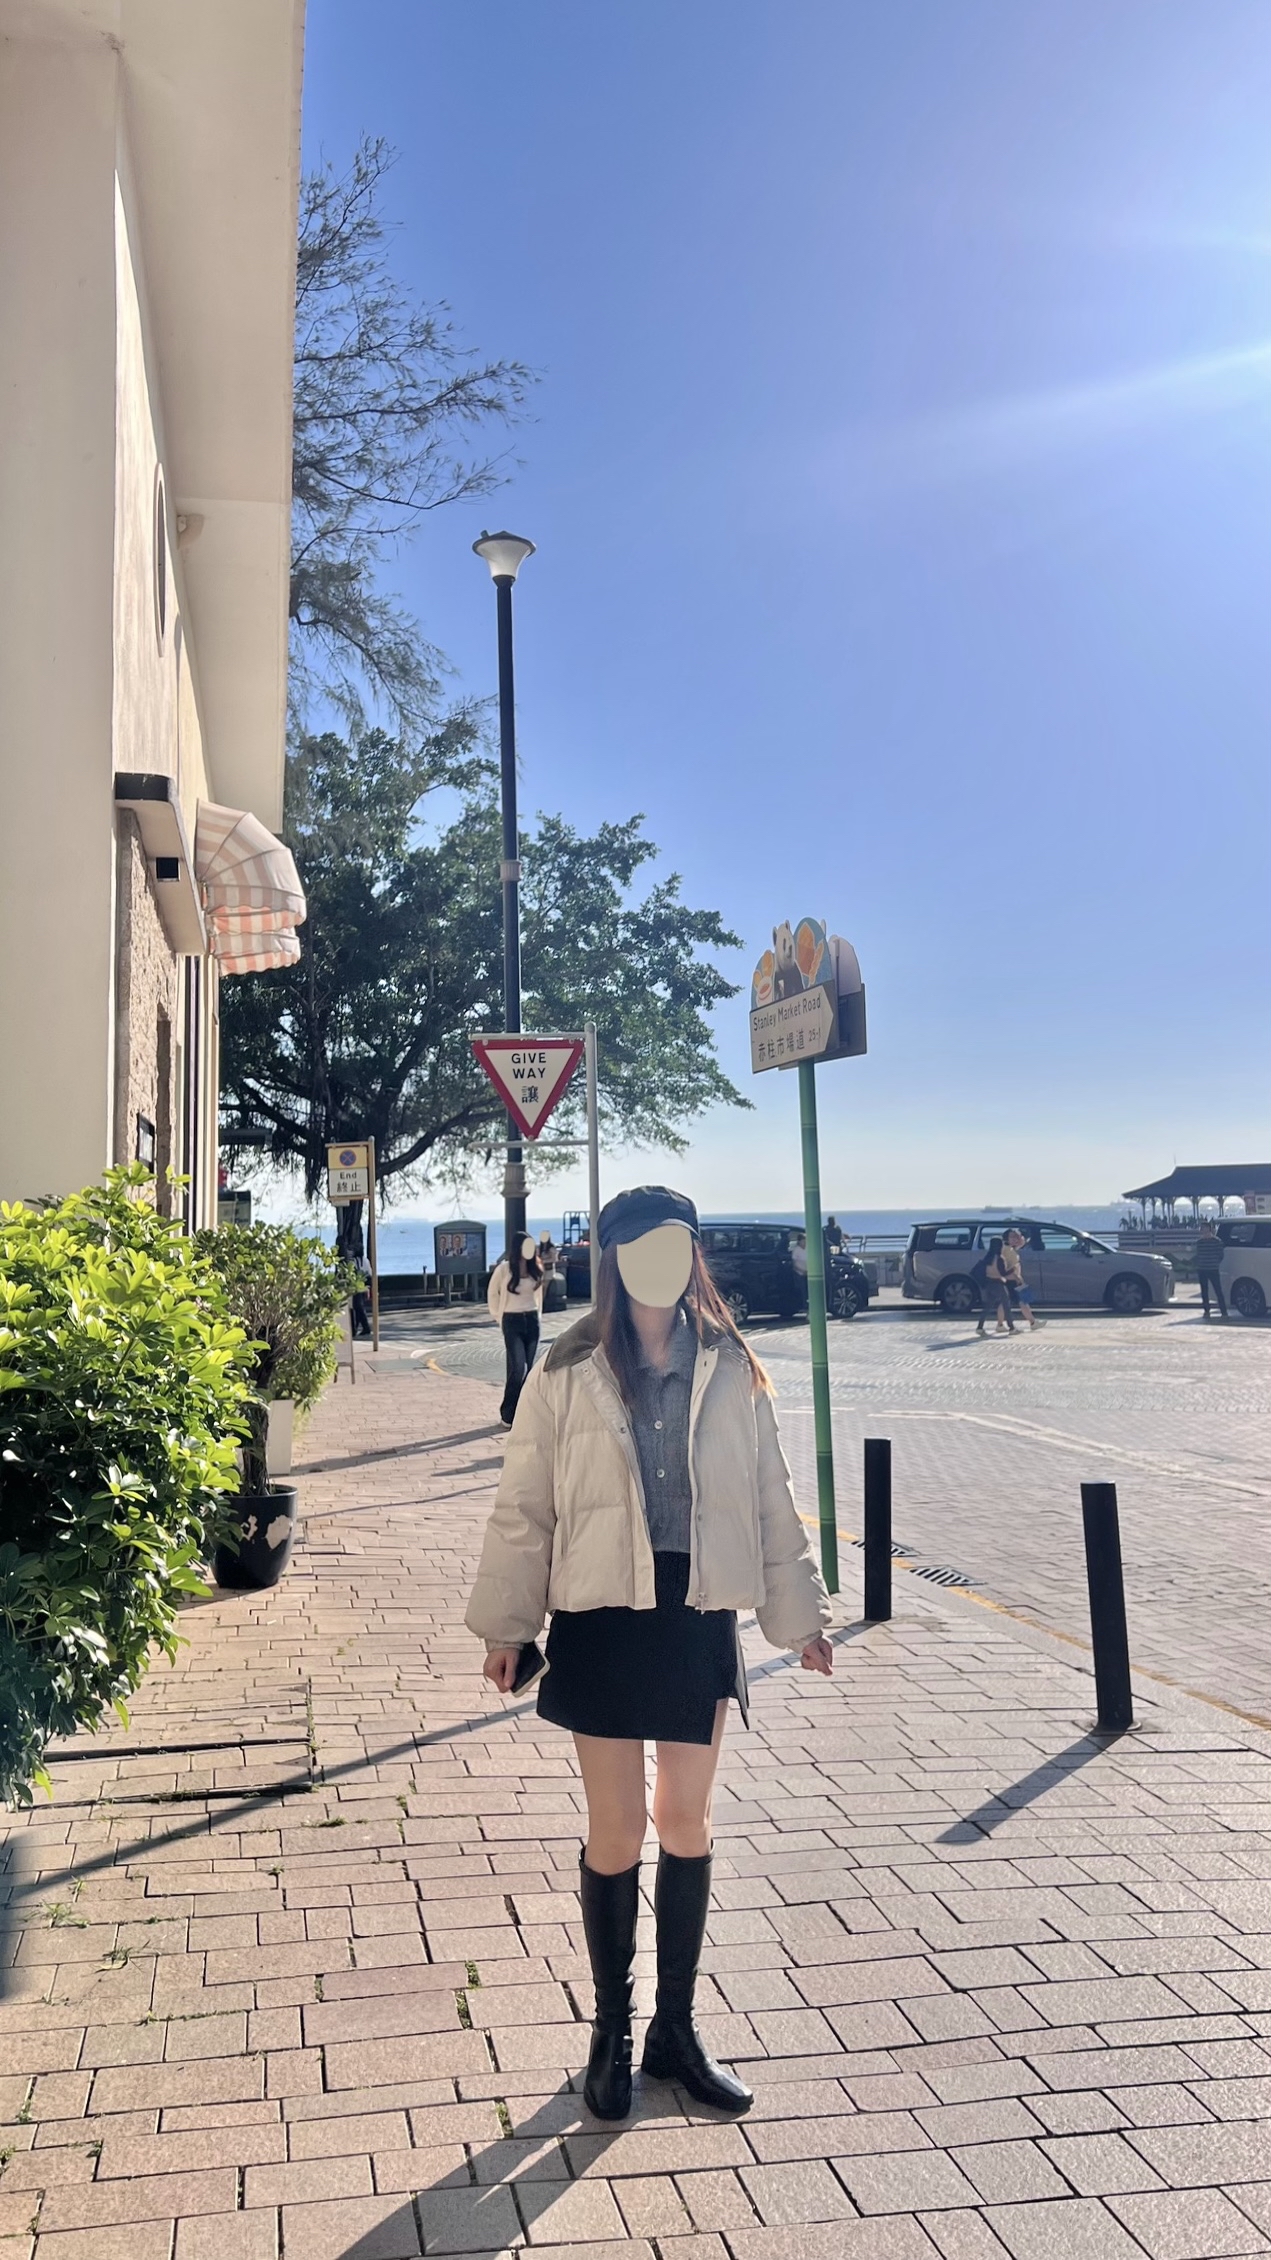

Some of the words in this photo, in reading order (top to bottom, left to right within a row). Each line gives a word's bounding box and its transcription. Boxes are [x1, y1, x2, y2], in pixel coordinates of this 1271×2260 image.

[753, 1012, 777, 1031] Stanley
[778, 1003, 801, 1022] Market
[802, 995, 821, 1013] Road
[758, 1028, 805, 1062] 赤柱市場道
[511, 1052, 547, 1064] GIVE
[512, 1067, 546, 1079] WAY
[521, 1085, 539, 1103] 讓
[340, 1171, 357, 1180] End
[336, 1181, 361, 1193] 終止
